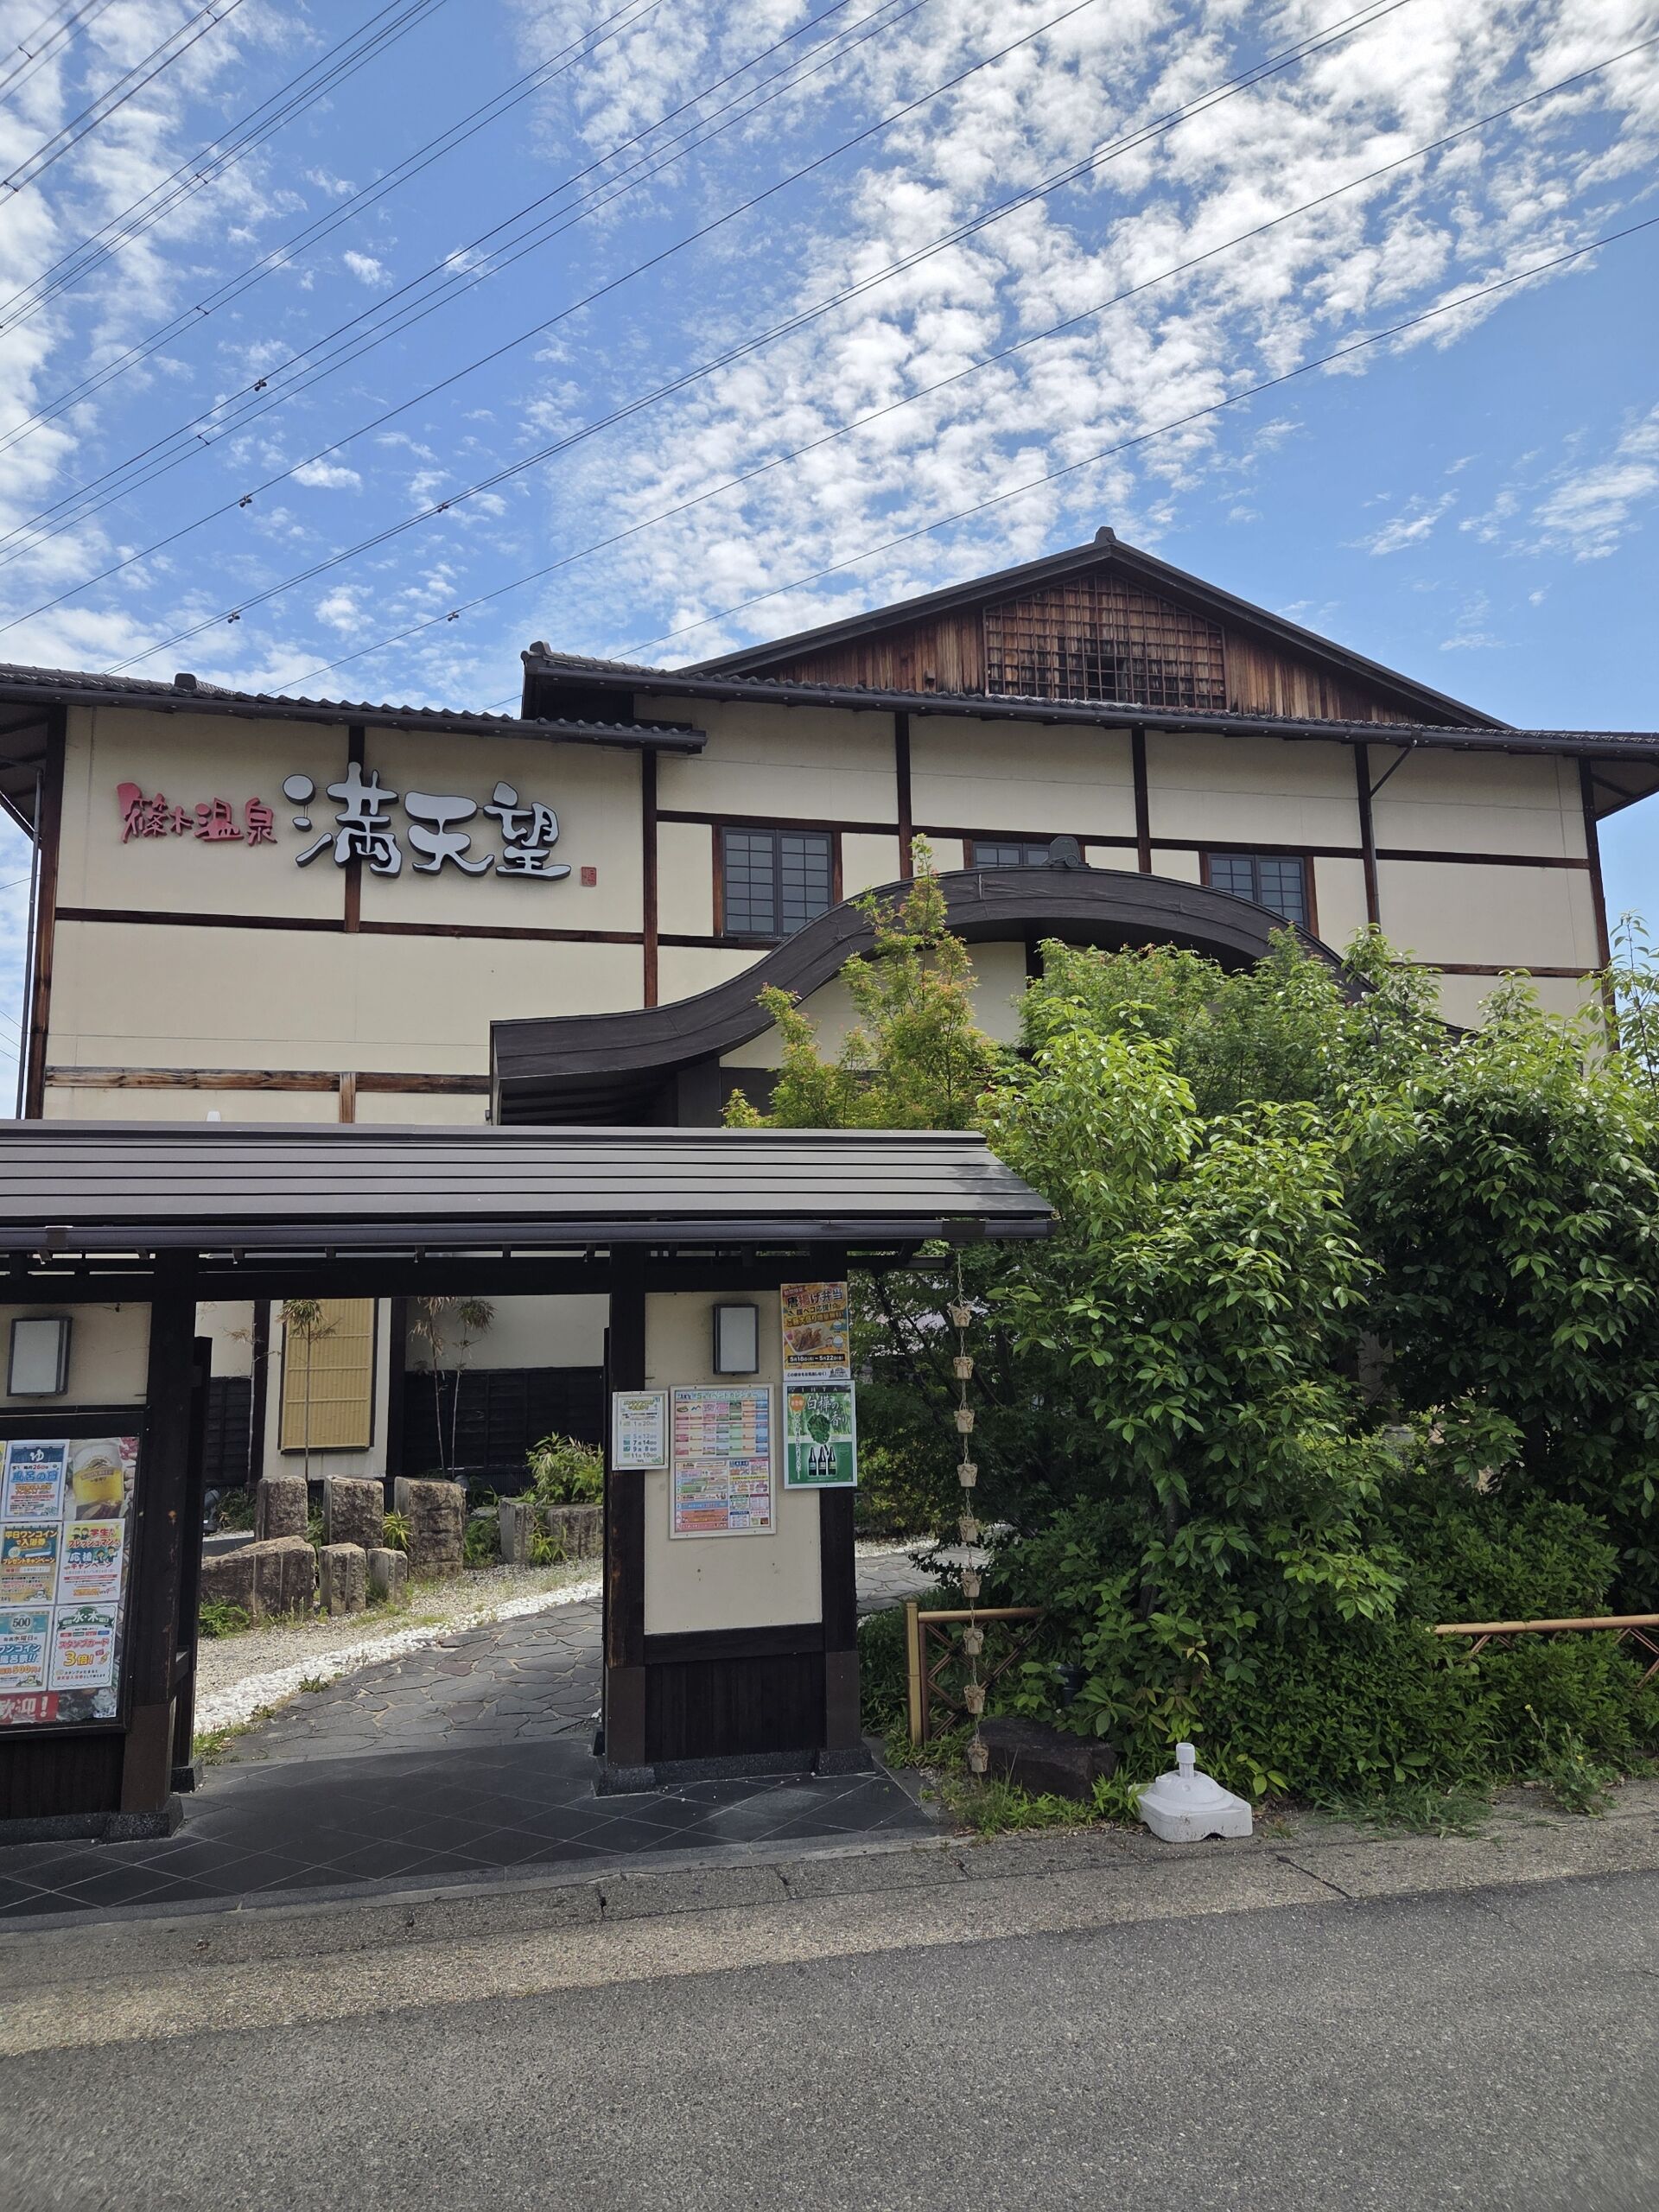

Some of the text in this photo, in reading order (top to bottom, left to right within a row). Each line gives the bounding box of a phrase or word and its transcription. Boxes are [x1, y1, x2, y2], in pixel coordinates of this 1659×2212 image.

[116, 761, 572, 880] 篠木温泉 満天望
[29, 1448, 45, 1462] ゆ
[5, 1529, 58, 1539] 平日ワンコイン
[12, 1617, 31, 1628] 500
